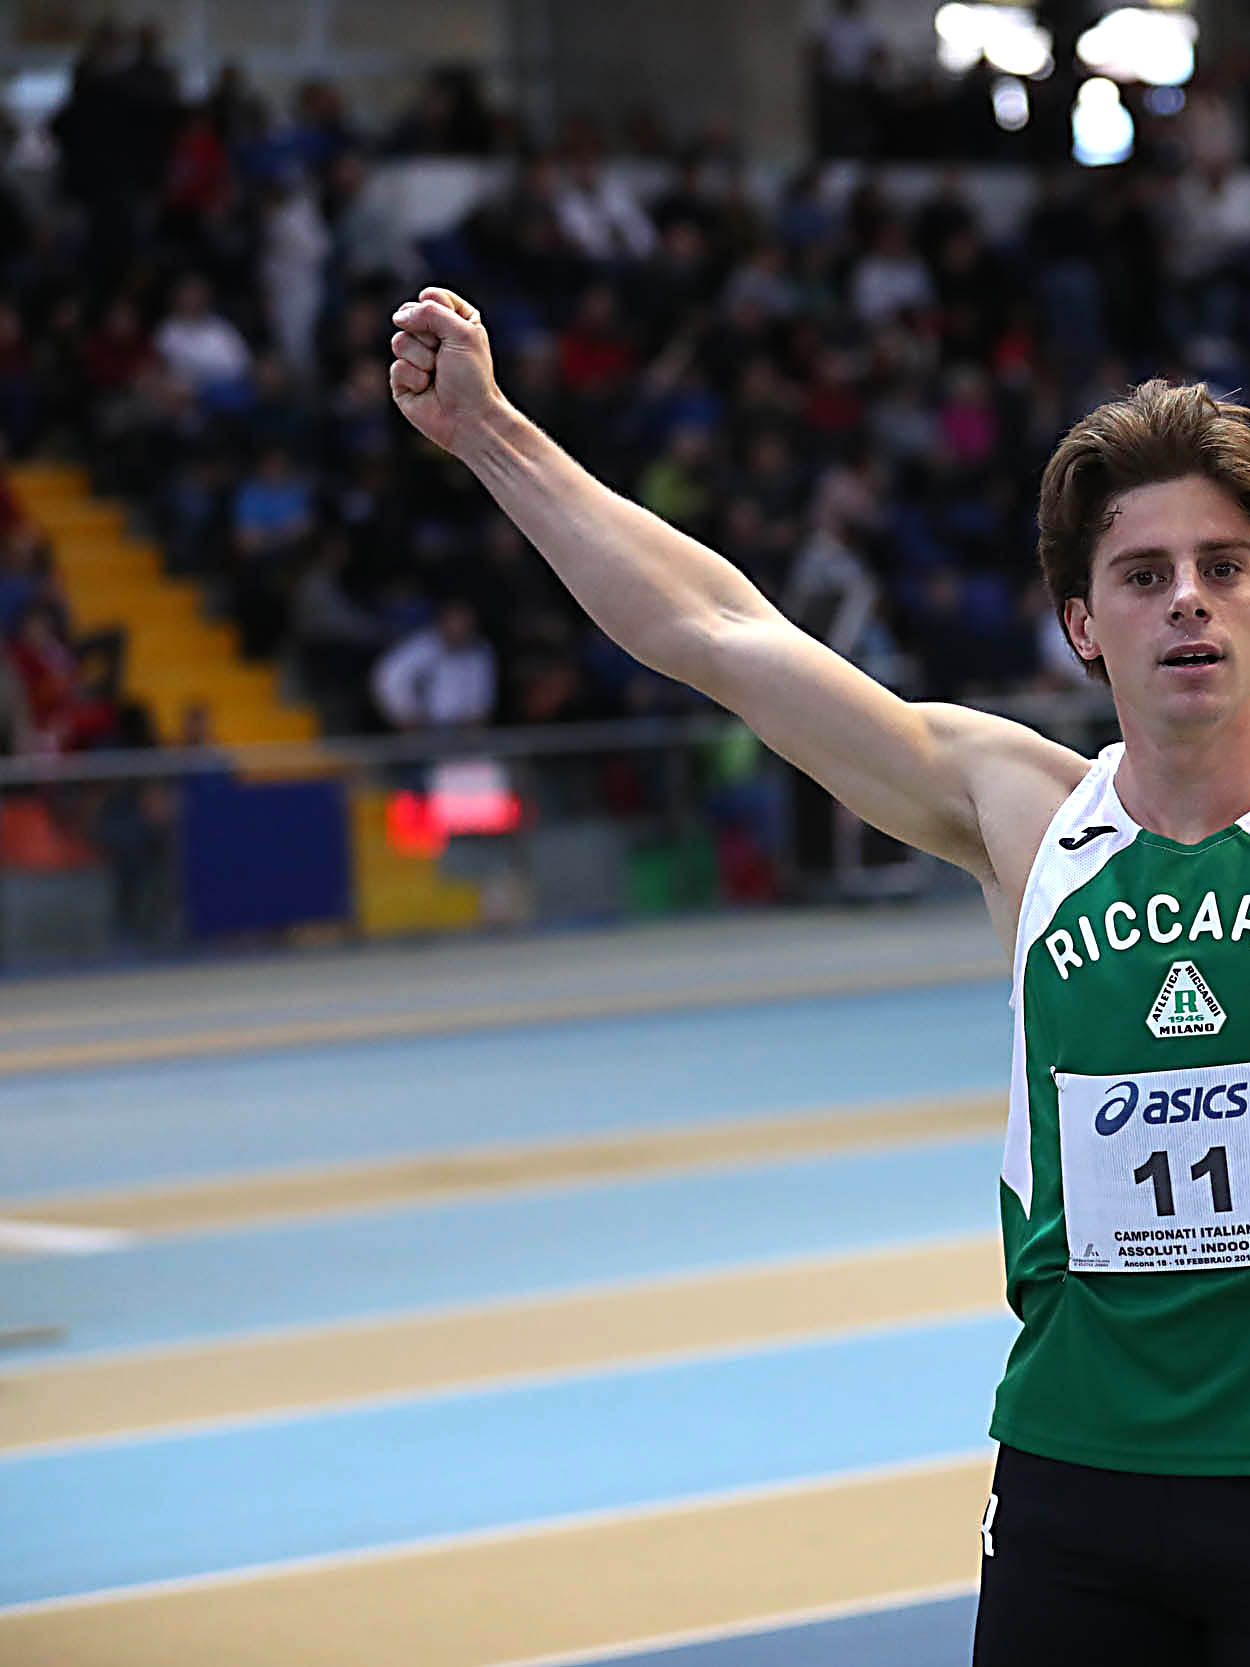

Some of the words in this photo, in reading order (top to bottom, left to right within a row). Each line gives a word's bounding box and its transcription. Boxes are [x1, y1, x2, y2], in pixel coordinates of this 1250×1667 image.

[1152, 968, 1182, 1022] ATLETICA
[1185, 965, 1221, 1017] RICCARDI
[1174, 990, 1198, 1013] R
[1168, 1014, 1205, 1023] 1946
[1159, 1023, 1215, 1035] MILANO
[1134, 1146, 1233, 1217] 11
[1114, 1228, 1197, 1241] CAMPIONATI
[1118, 1245, 1188, 1257] ASSOLUTI
[1187, 1255, 1233, 1265] FEBBRAIO
